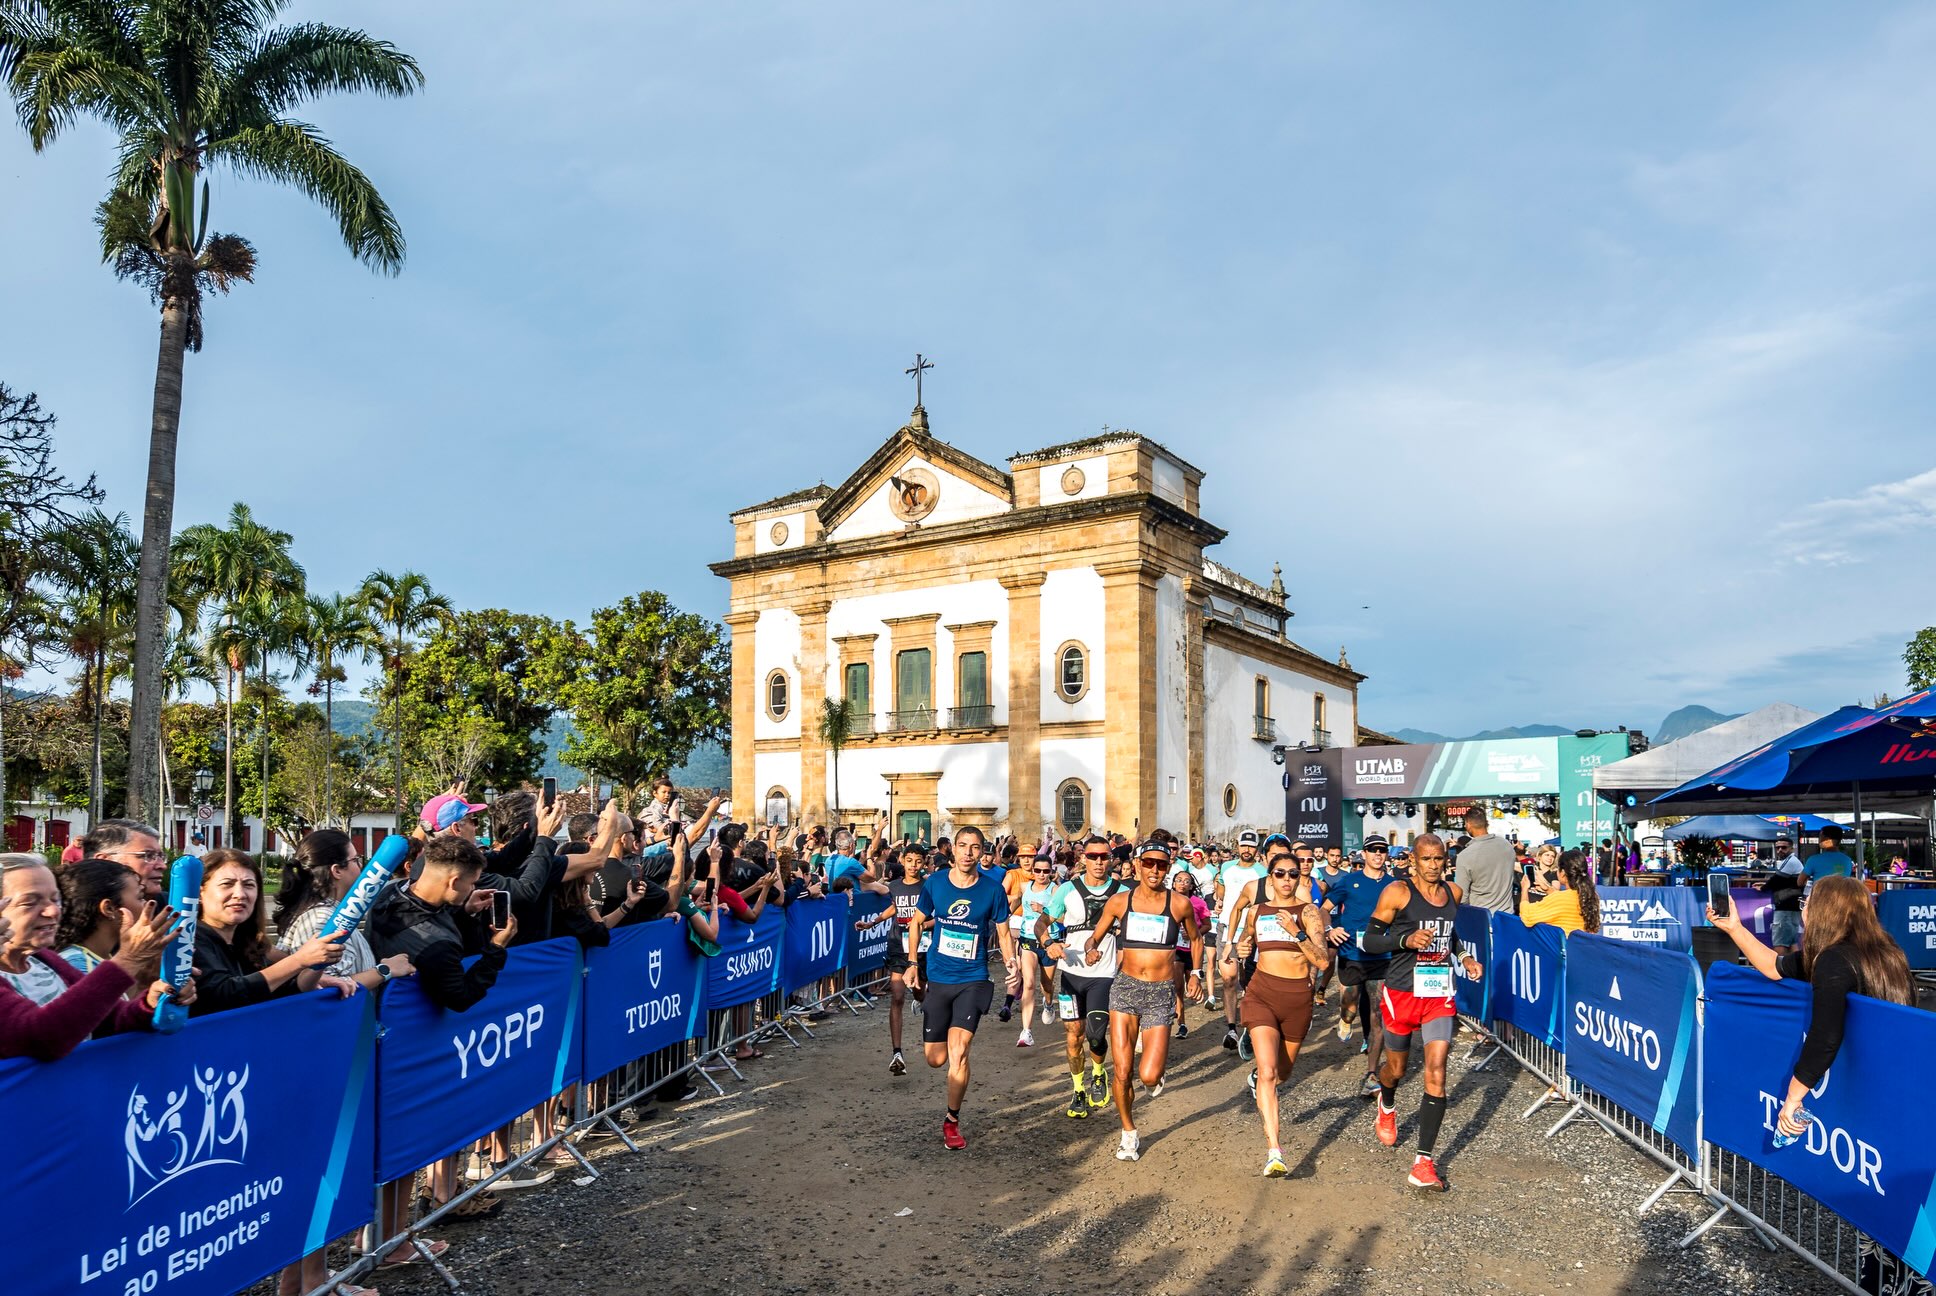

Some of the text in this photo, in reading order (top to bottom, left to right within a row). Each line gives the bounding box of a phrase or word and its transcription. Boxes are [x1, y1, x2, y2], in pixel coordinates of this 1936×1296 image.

[1355, 759, 1404, 775] UTMB
[1298, 824, 1328, 833] HOKA
[340, 861, 390, 918] HOKA
[1600, 899, 1649, 912] ARATY
[175, 896, 200, 972] HOKA
[866, 943, 885, 957] HUMAN
[946, 941, 966, 951] 6365
[1608, 928, 1659, 939] BY UTMB
[726, 945, 773, 981] SUUNTO
[1423, 979, 1442, 988] 6006
[625, 993, 682, 1035] TUDOR
[452, 1003, 545, 1080] YOPP
[1575, 1001, 1661, 1071] SUUNTO
[1759, 1089, 1886, 1197] TDOR
[80, 1175, 284, 1285] Lei de Incentivo
[123, 1219, 260, 1296] ao Esporte
